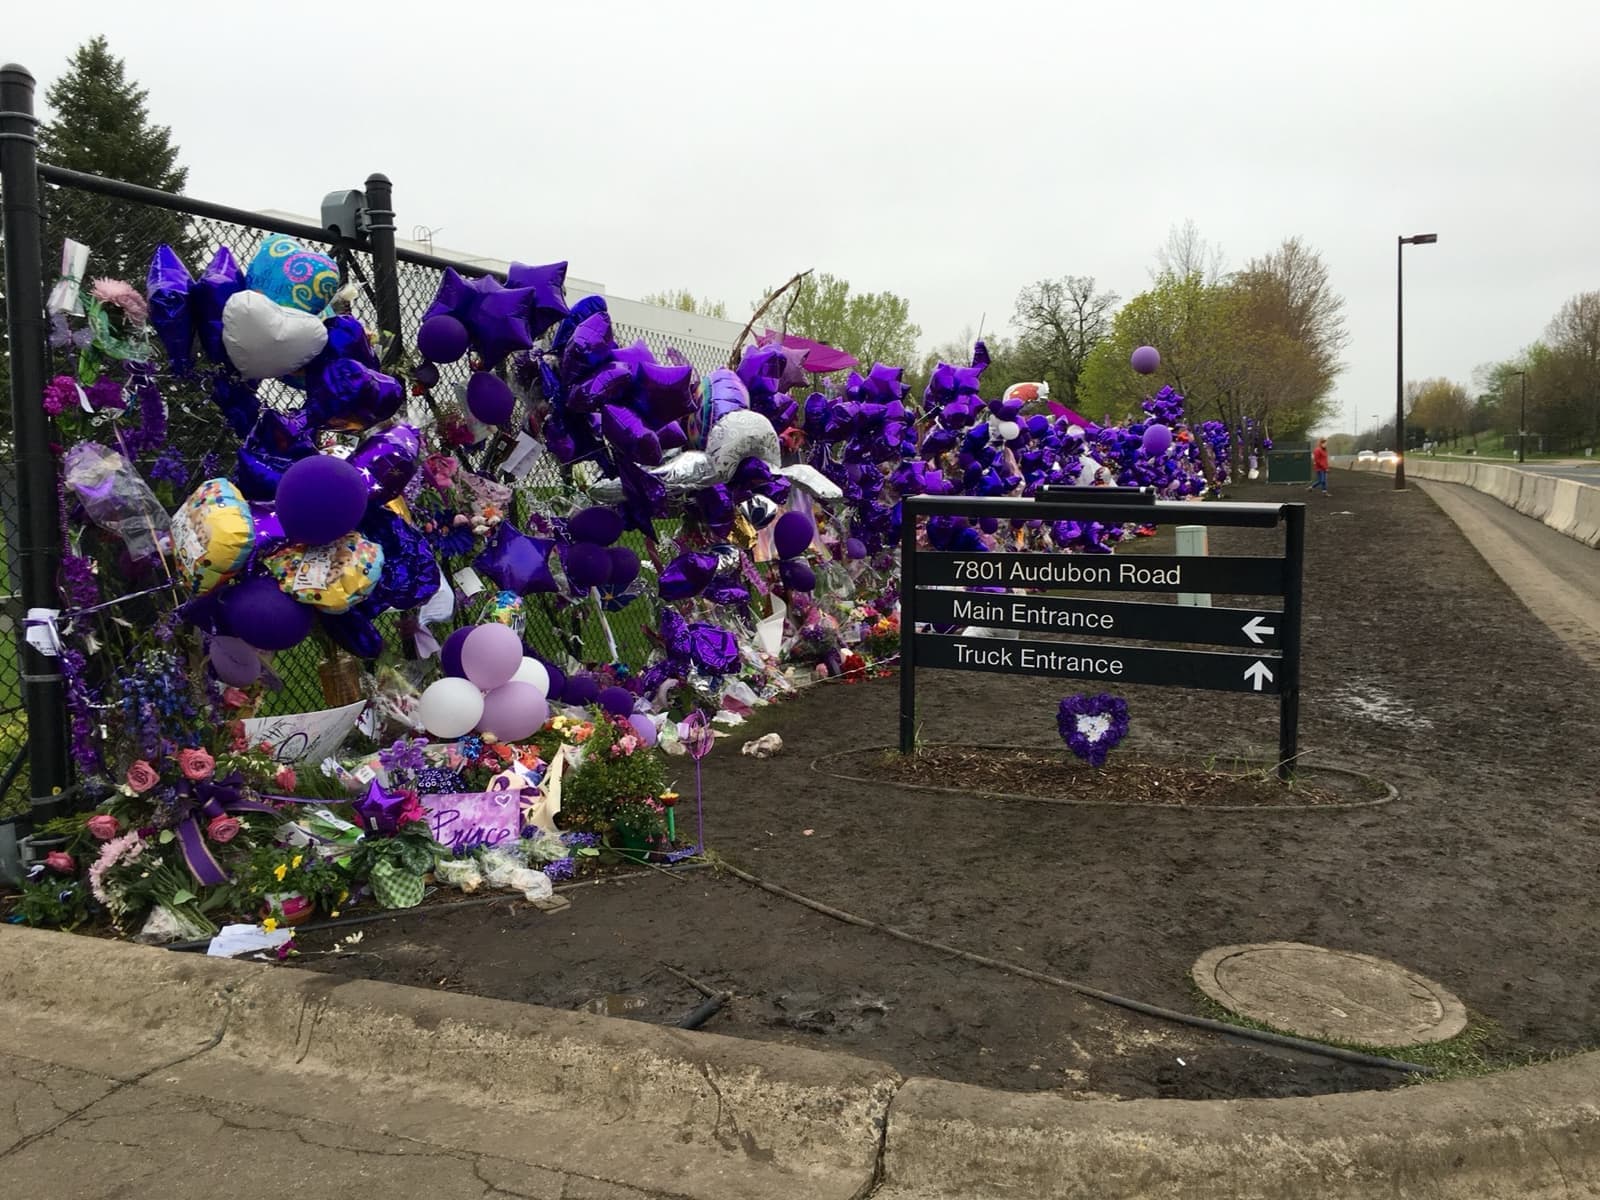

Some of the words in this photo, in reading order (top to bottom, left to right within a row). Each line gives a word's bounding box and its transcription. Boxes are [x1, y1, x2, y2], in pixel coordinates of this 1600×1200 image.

[952, 560, 1003, 581] 7801
[1010, 561, 1111, 583] Audubon
[1119, 563, 1182, 585] Road
[953, 600, 1004, 622] Main
[1012, 604, 1115, 629] Entrance
[953, 643, 1014, 666] Truck
[1020, 648, 1124, 674] Entrance
[432, 809, 511, 847] Prince
